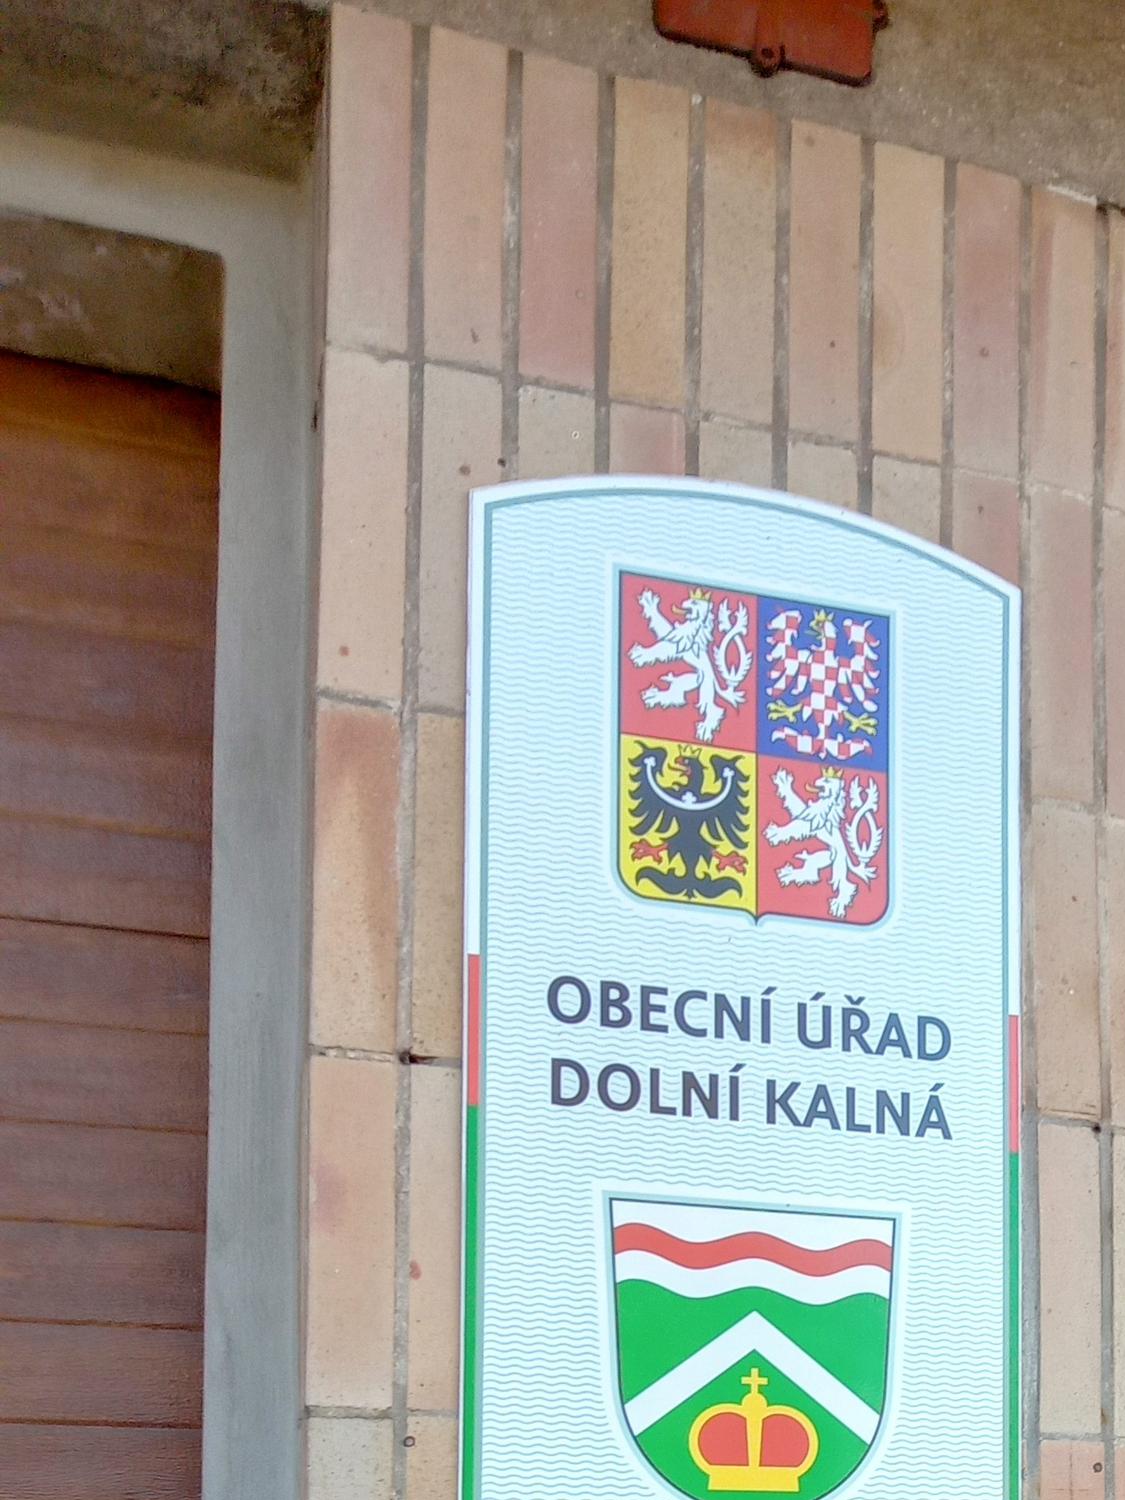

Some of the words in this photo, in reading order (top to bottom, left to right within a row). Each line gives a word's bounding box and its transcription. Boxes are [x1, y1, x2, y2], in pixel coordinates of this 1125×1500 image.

[547, 975, 777, 1044] OBECNÍ
[797, 991, 952, 1062] ÚŘAD
[550, 1057, 747, 1122] DOLNÍ
[766, 1079, 953, 1141] KALNÁ
